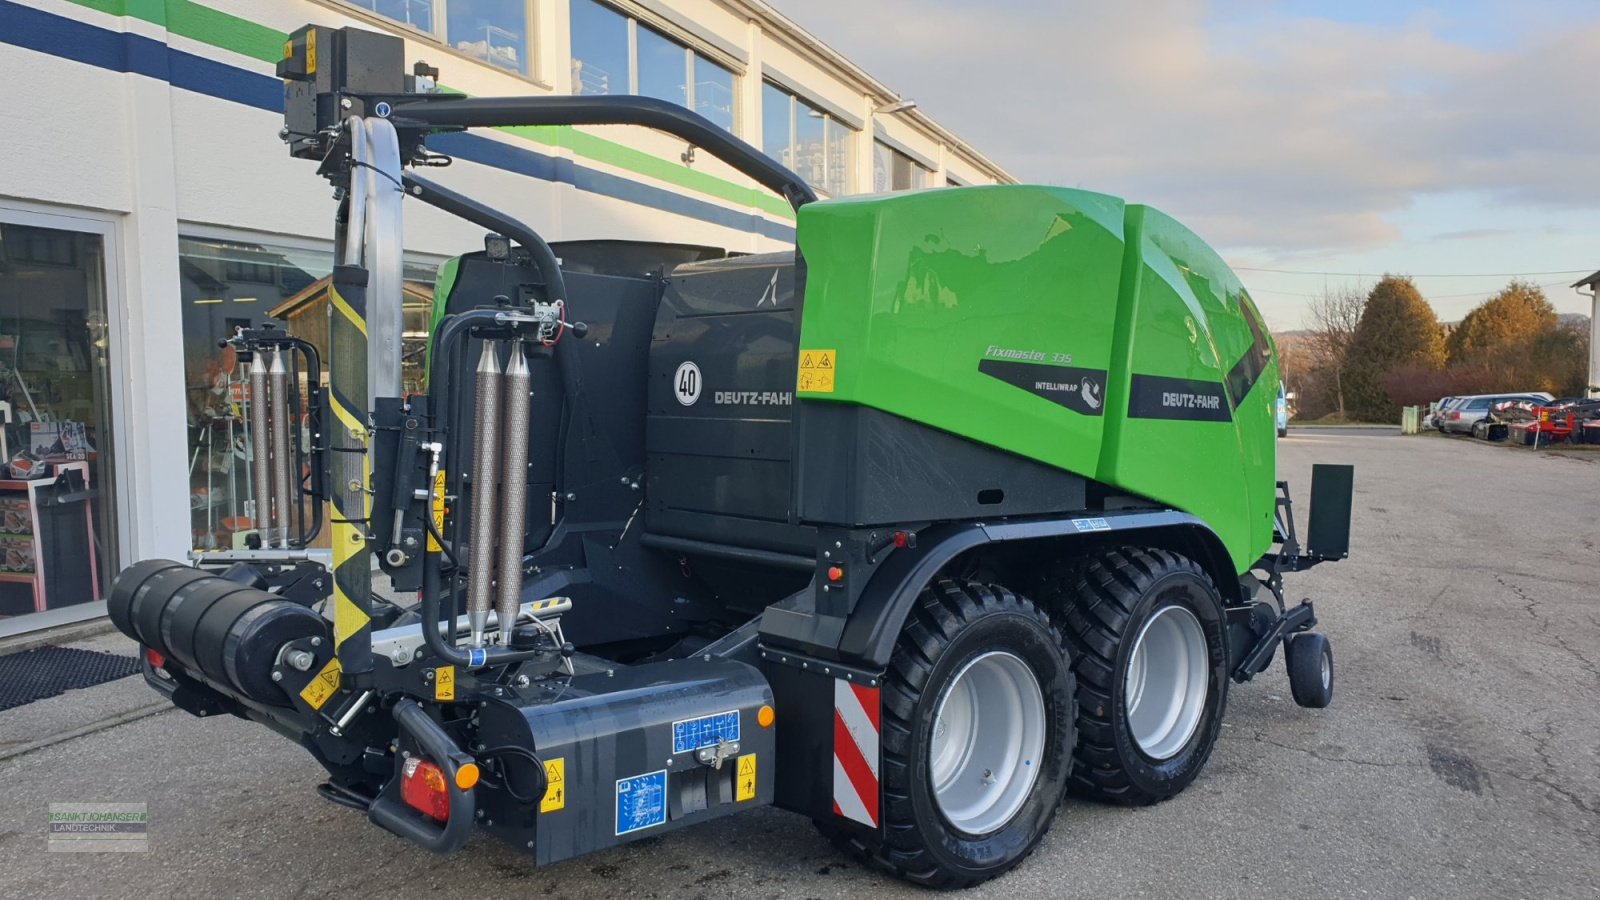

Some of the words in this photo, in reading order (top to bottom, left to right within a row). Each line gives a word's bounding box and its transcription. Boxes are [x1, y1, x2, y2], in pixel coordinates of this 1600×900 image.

[985, 345, 1046, 361] Fixmaster
[1052, 353, 1073, 363] 335
[679, 369, 696, 397] 40
[1035, 381, 1078, 392] INTELLIWRAP
